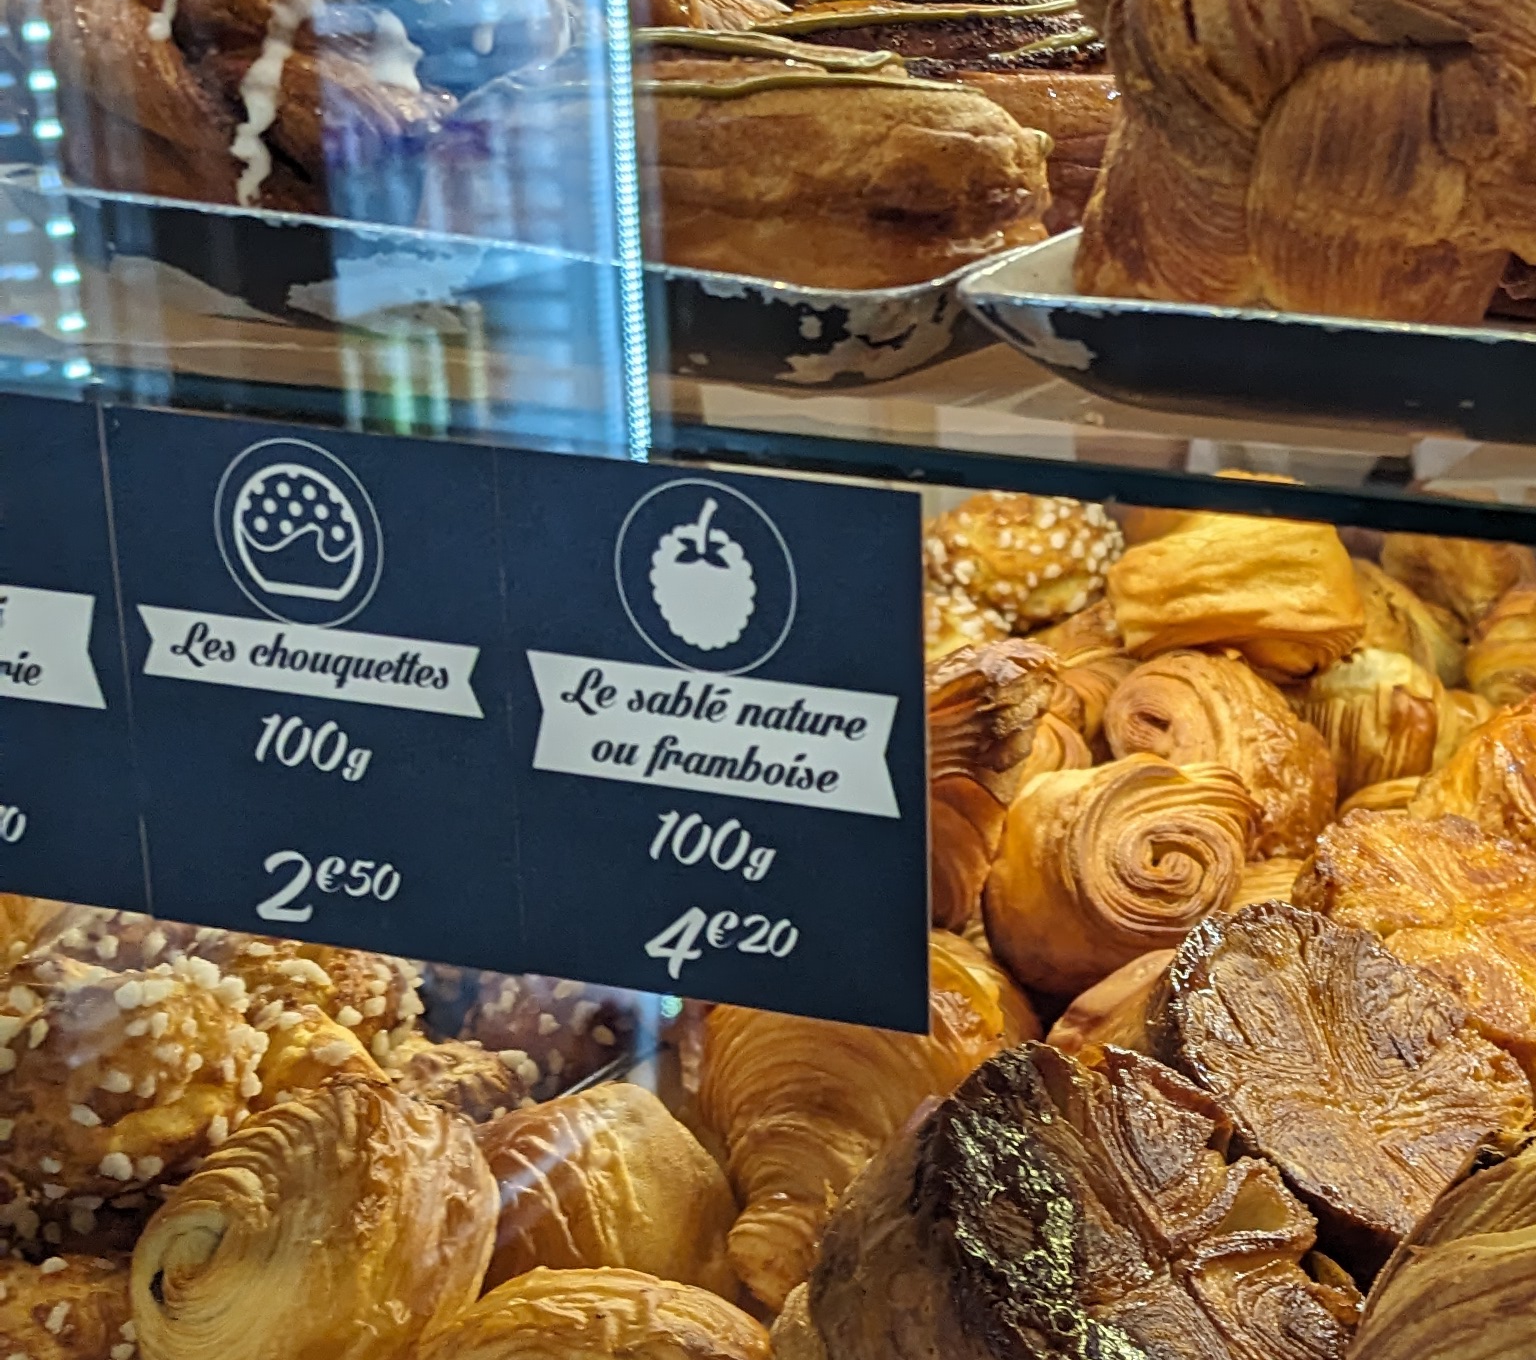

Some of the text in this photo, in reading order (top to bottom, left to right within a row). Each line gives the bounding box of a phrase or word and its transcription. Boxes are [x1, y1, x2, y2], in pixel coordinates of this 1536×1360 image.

[169, 621, 449, 690] Les chouquettes
[560, 668, 868, 741] Le sablé nature
[254, 713, 372, 782] 100g
[591, 735, 839, 793] ou framboise
[649, 810, 777, 881] 100g
